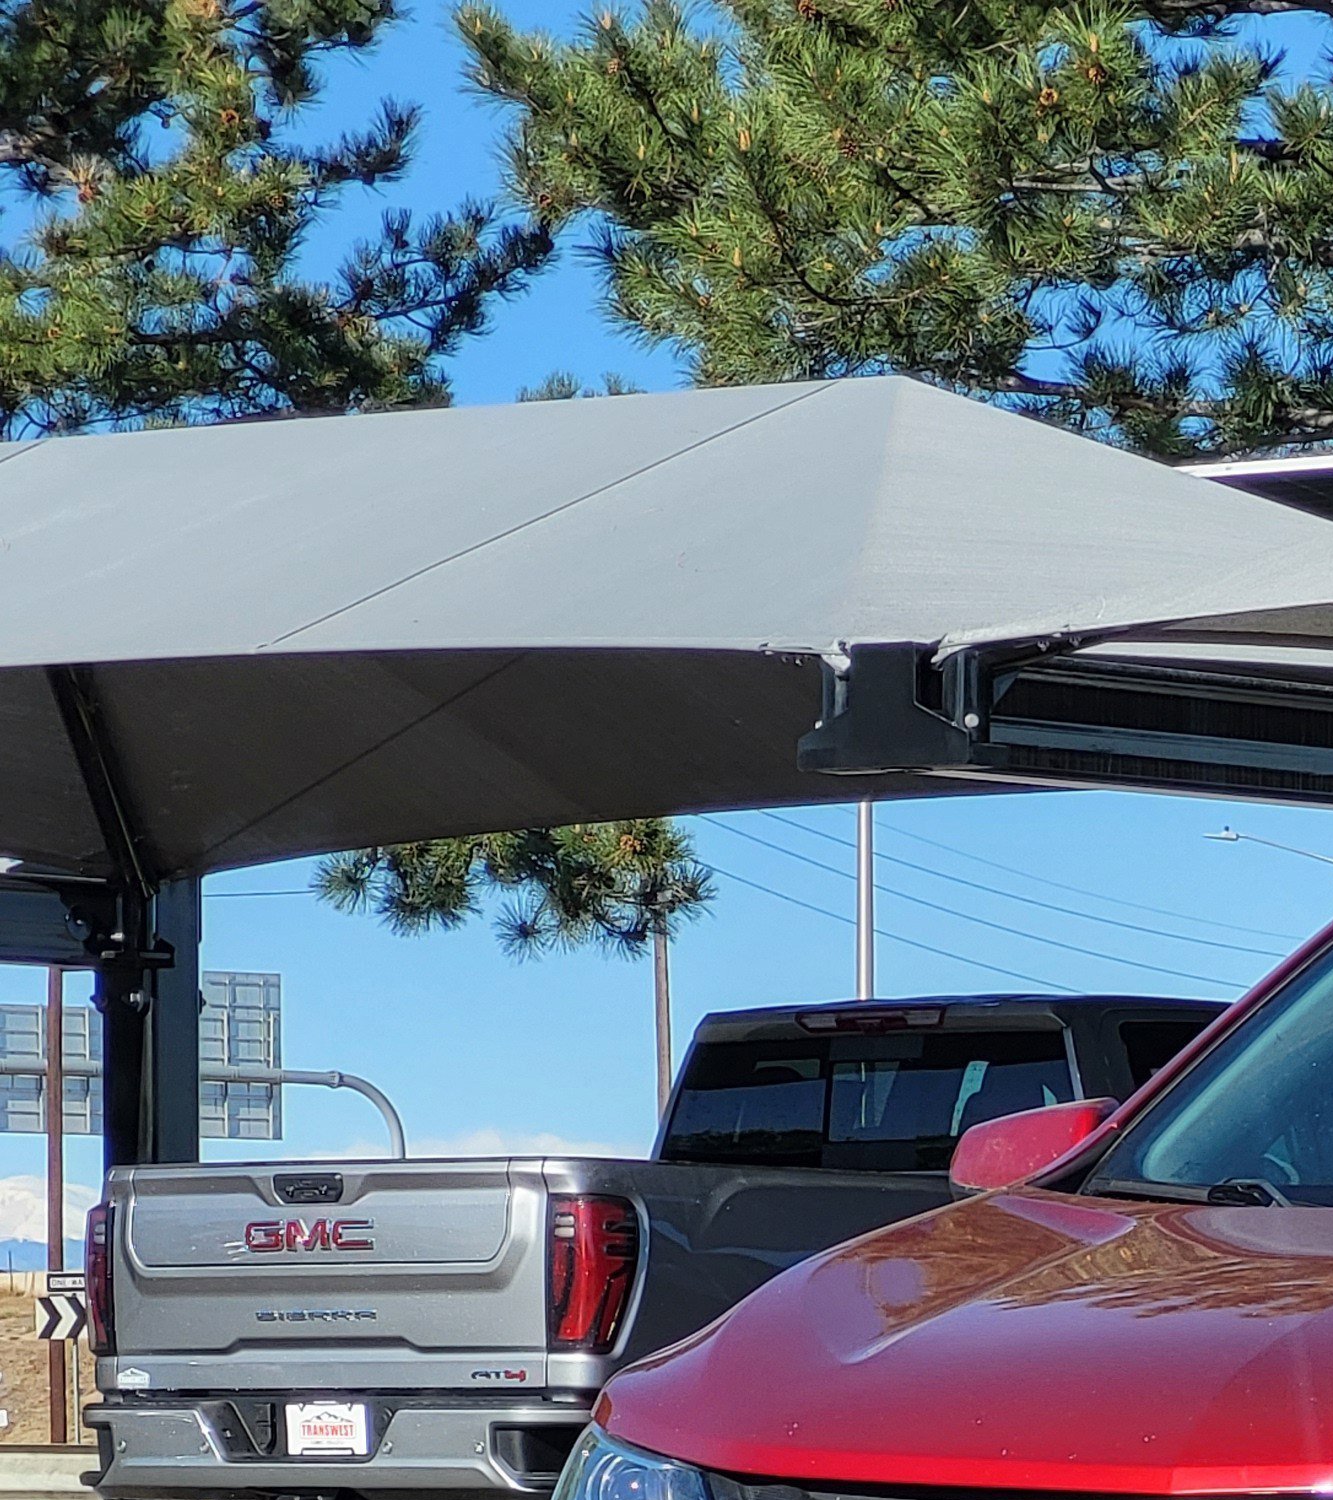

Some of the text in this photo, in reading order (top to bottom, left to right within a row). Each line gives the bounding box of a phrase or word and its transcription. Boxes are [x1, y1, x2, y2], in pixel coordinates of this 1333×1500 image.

[245, 1218, 375, 1252] GMC
[255, 1309, 377, 1322] SIERRA
[470, 1369, 527, 1383] AT4
[301, 1424, 354, 1437] TRANSWEST
